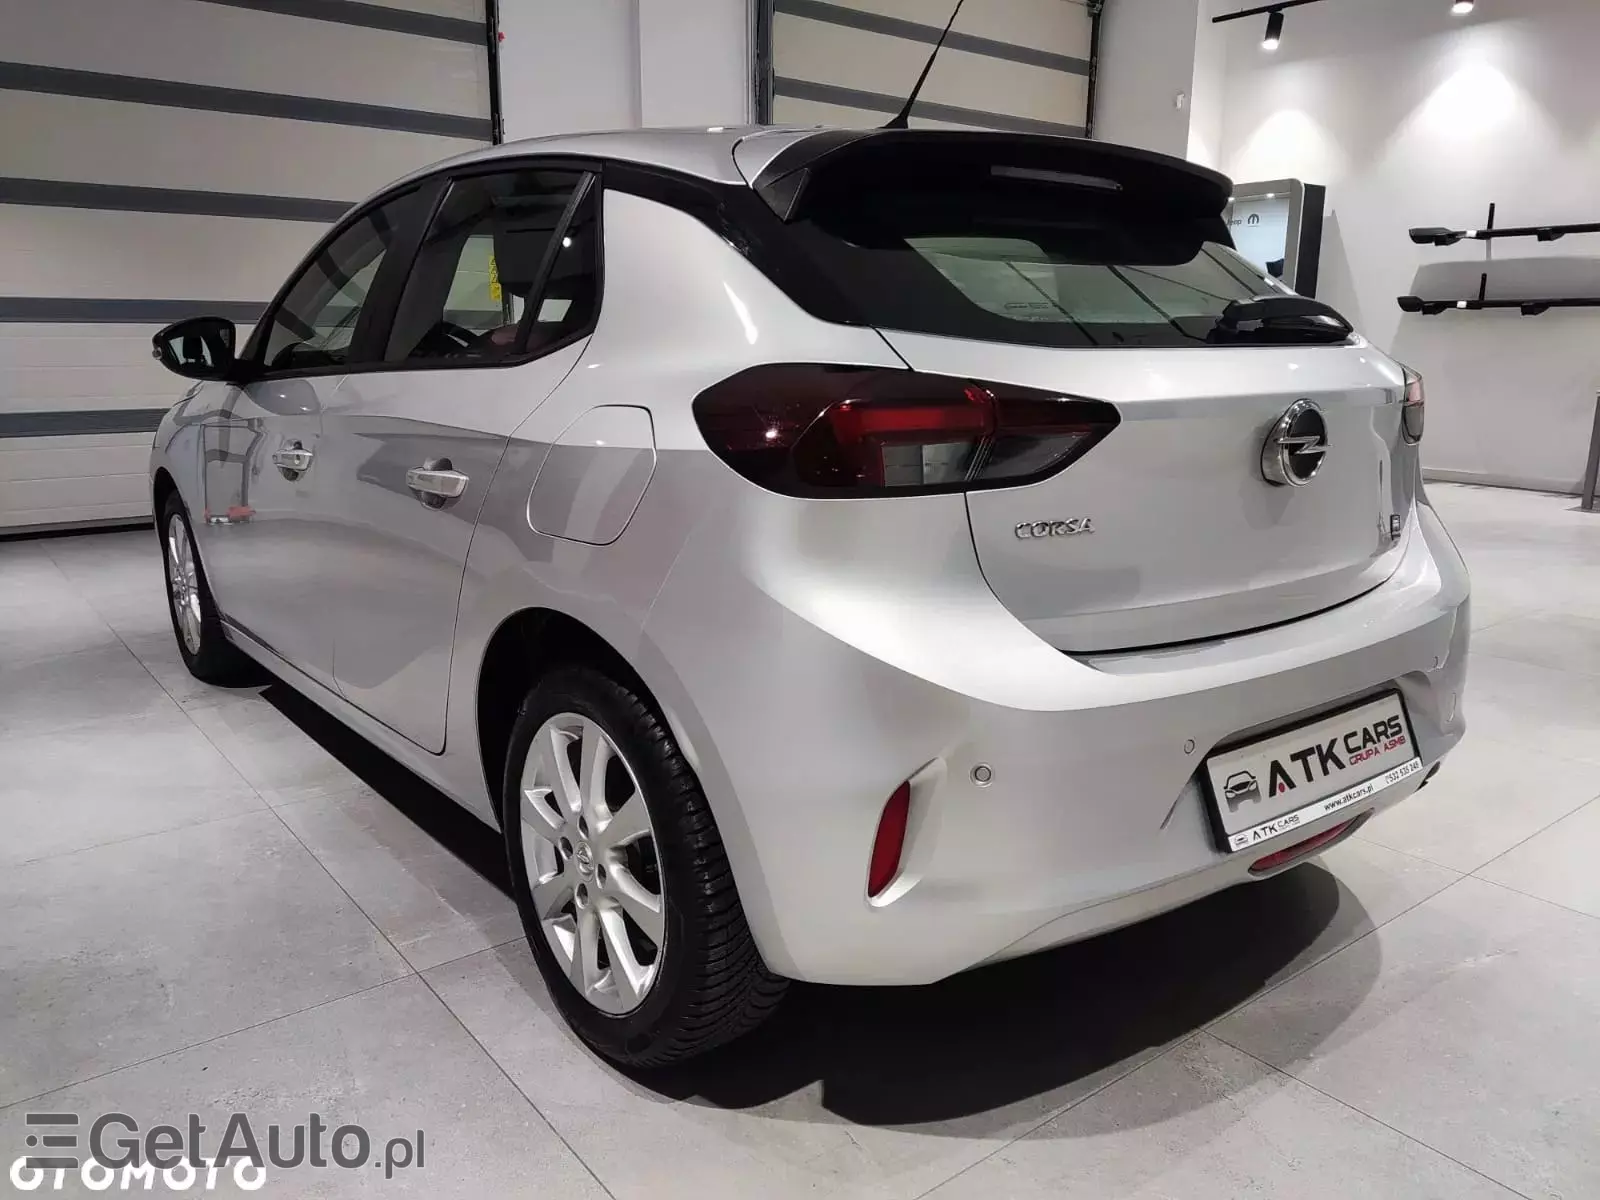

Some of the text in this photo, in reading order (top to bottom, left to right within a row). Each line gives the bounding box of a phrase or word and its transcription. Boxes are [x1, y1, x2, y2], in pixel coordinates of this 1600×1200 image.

[1015, 518, 1095, 539] CORSA
[1269, 715, 1402, 798] ATK CARS
[1349, 746, 1380, 765] GRUPA
[1253, 824, 1278, 841] ATK
[1277, 815, 1299, 828] CARS
[1324, 783, 1374, 811] www.atkcars.pl
